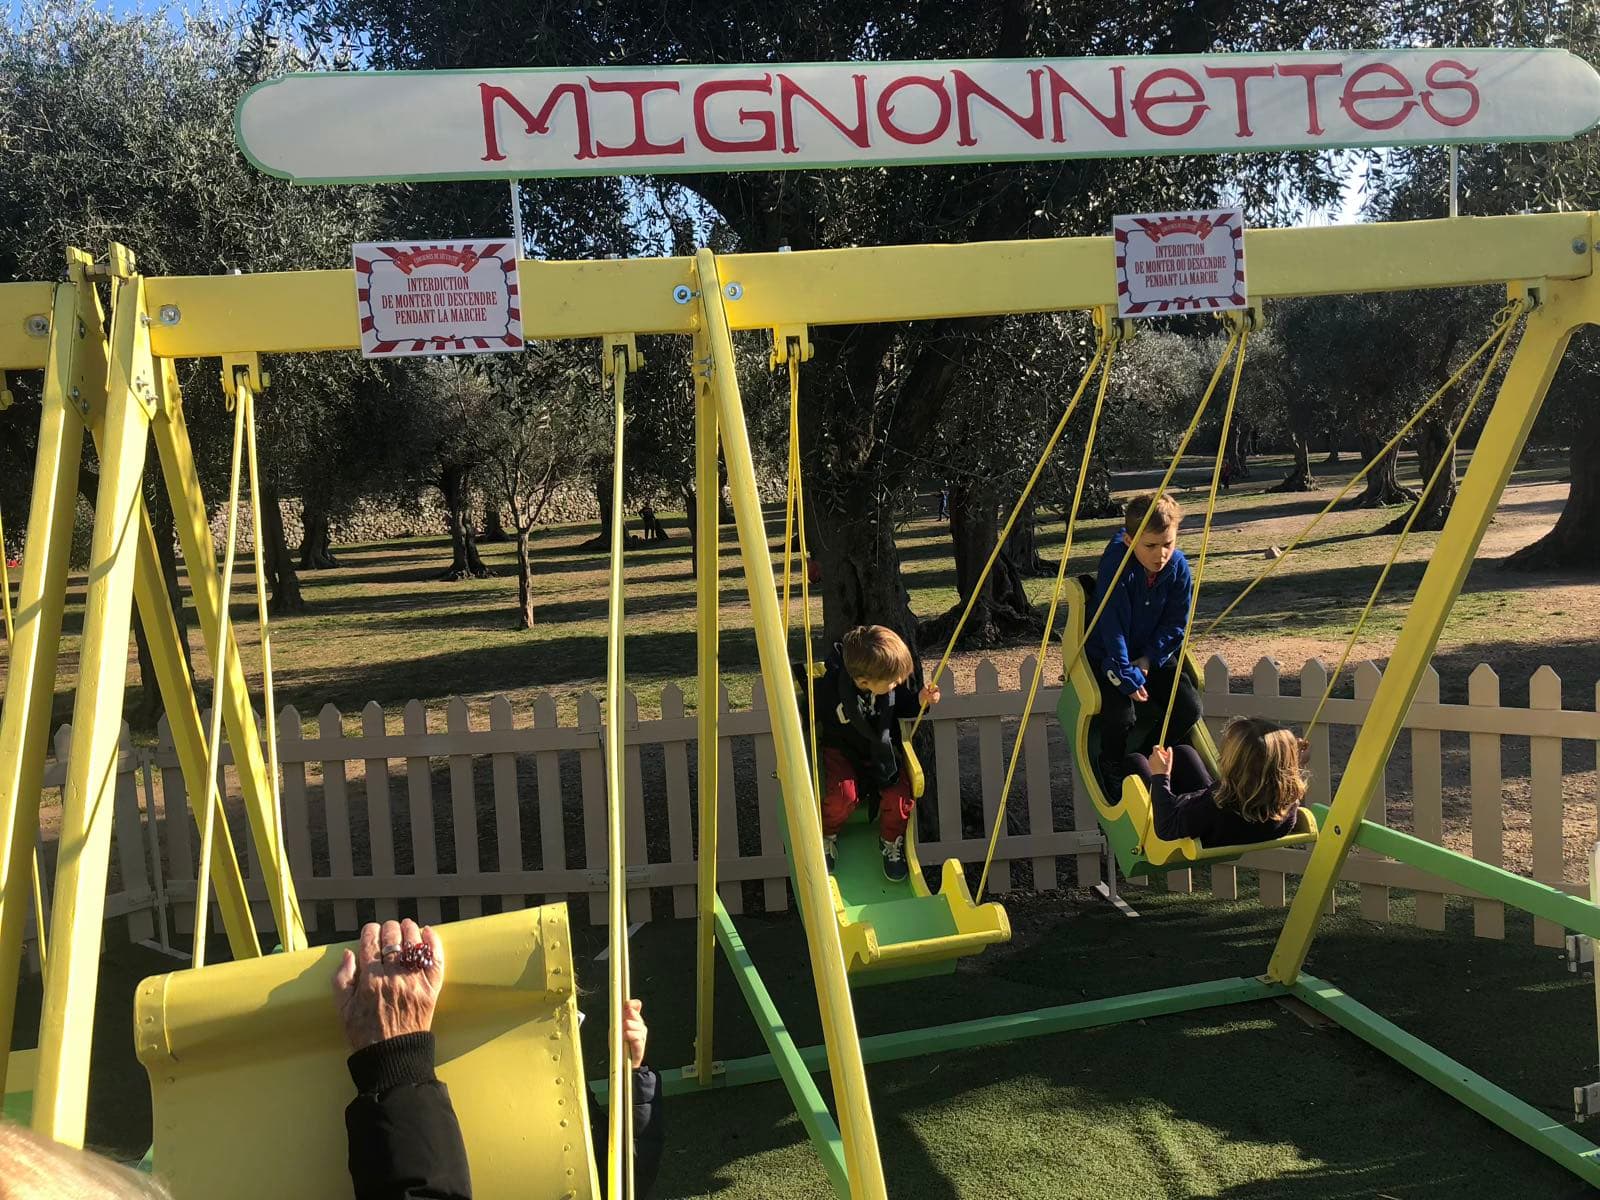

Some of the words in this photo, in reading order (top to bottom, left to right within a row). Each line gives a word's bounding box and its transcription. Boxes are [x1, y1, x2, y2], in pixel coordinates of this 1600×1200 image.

[1155, 243, 1205, 258] INTERDICTION
[1135, 261, 1144, 274] DE
[1146, 259, 1175, 273] MONTER
[1176, 259, 1186, 270] OU
[1188, 256, 1226, 270] DESCENDRE
[407, 276, 469, 292] INTERDICTION
[1145, 274, 1178, 288] PENDANT
[1180, 273, 1188, 286] LA
[1189, 271, 1218, 284] MARCHE
[382, 295, 393, 309] DE
[395, 293, 432, 308] MONTER
[434, 293, 445, 306] OU
[448, 292, 497, 306] DESCENDRE
[395, 309, 435, 324] PENDANT
[438, 309, 449, 323] LA
[450, 308, 487, 322] MARCHE
